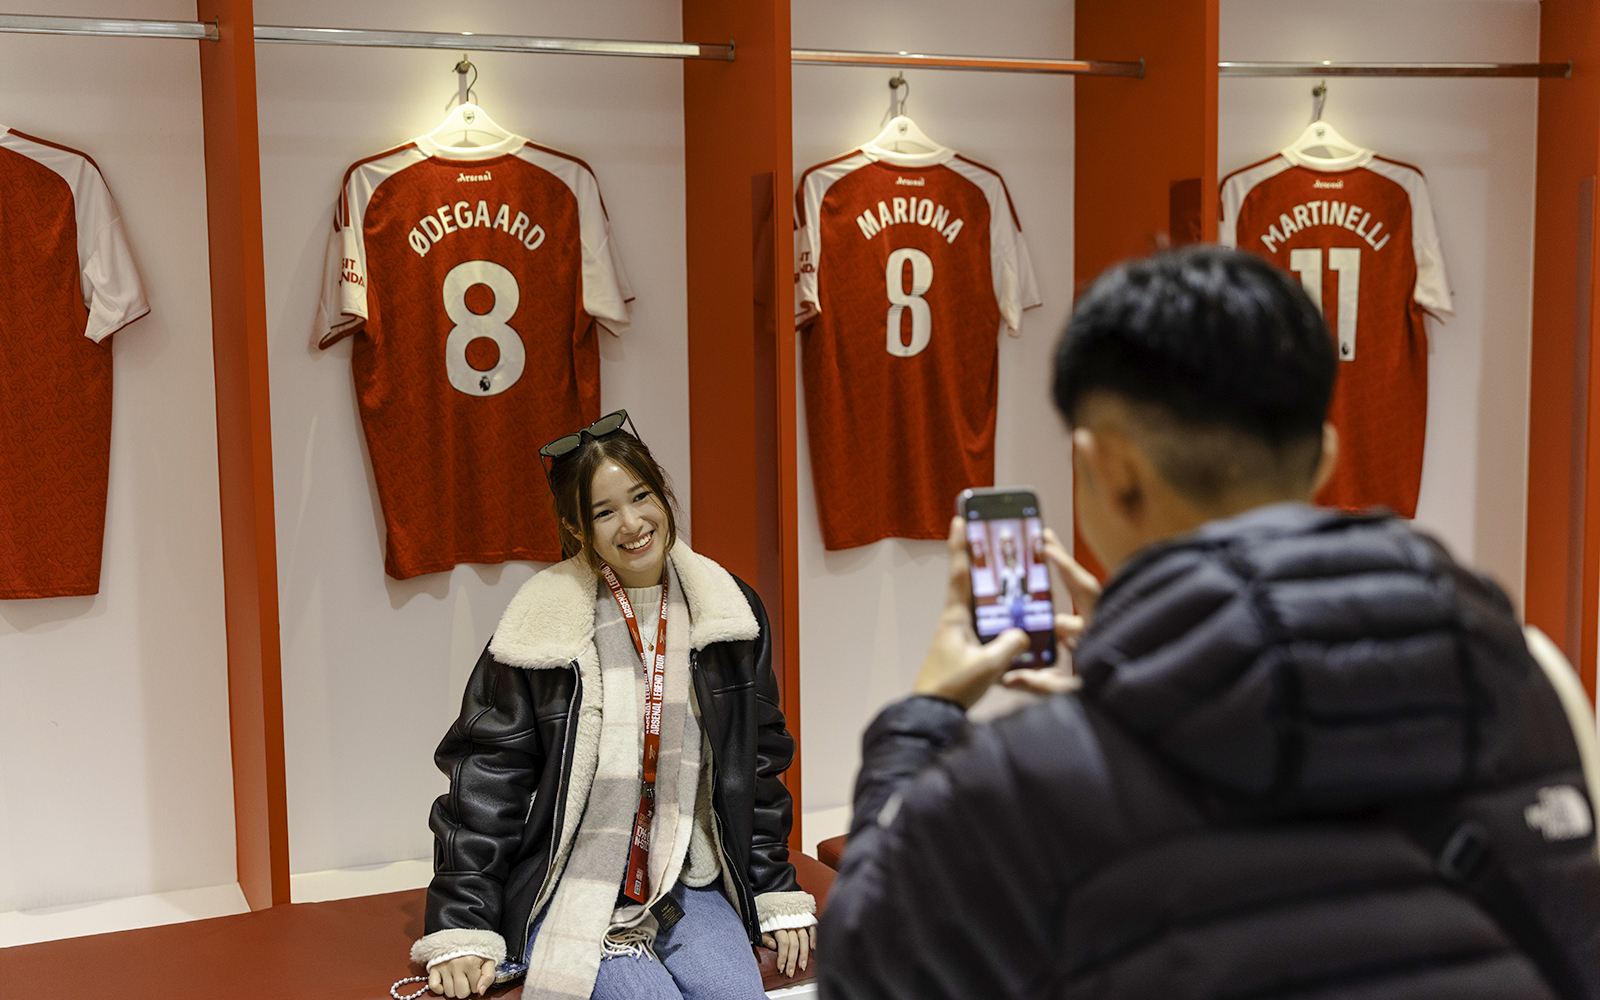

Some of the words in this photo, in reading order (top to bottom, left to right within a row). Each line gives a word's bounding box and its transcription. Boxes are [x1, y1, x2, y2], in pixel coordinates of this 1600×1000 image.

[457, 170, 492, 182] Arsenal
[408, 200, 546, 257] ØDEGAARD
[857, 197, 964, 243] MARIONA
[1260, 200, 1390, 254] MARTINELLI
[886, 247, 934, 357] 8
[1290, 248, 1361, 362] 11
[442, 260, 526, 397] 8
[614, 588, 634, 619] ARSENAL
[655, 654, 665, 673] TOUR
[652, 674, 664, 700] LEGEND
[650, 702, 662, 735] ARSENAL
